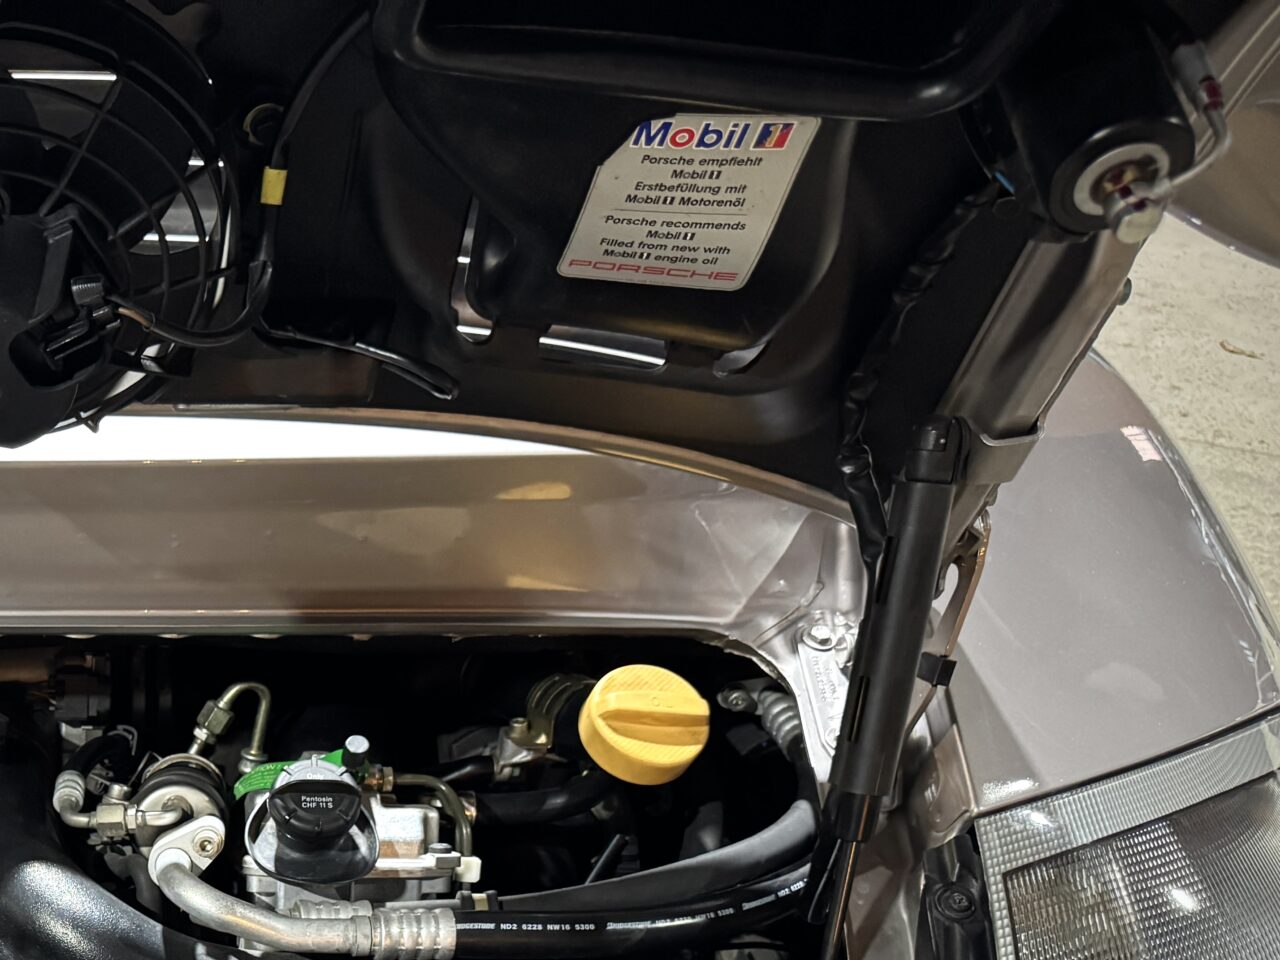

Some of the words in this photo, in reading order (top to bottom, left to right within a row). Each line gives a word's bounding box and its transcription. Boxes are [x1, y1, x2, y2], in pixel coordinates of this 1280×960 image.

[631, 121, 750, 148] Mobil
[641, 155, 694, 166] Porsche
[699, 157, 762, 168] empfiehlt
[671, 169, 707, 180] Mobil
[635, 181, 720, 195] Erstbefüllung
[724, 184, 747, 194] mit
[625, 194, 660, 205] Mobil
[678, 196, 745, 208] Motorenöl
[605, 215, 656, 227] Porsche
[661, 219, 745, 231] recommends
[646, 230, 681, 240] Mobil
[600, 238, 634, 249] Filled
[637, 240, 668, 251] from
[671, 245, 699, 253] new
[703, 246, 730, 255] with
[603, 249, 636, 259] Mobil
[654, 254, 698, 265] engine
[702, 256, 719, 266] oil
[568, 259, 739, 281] PORSCHE
